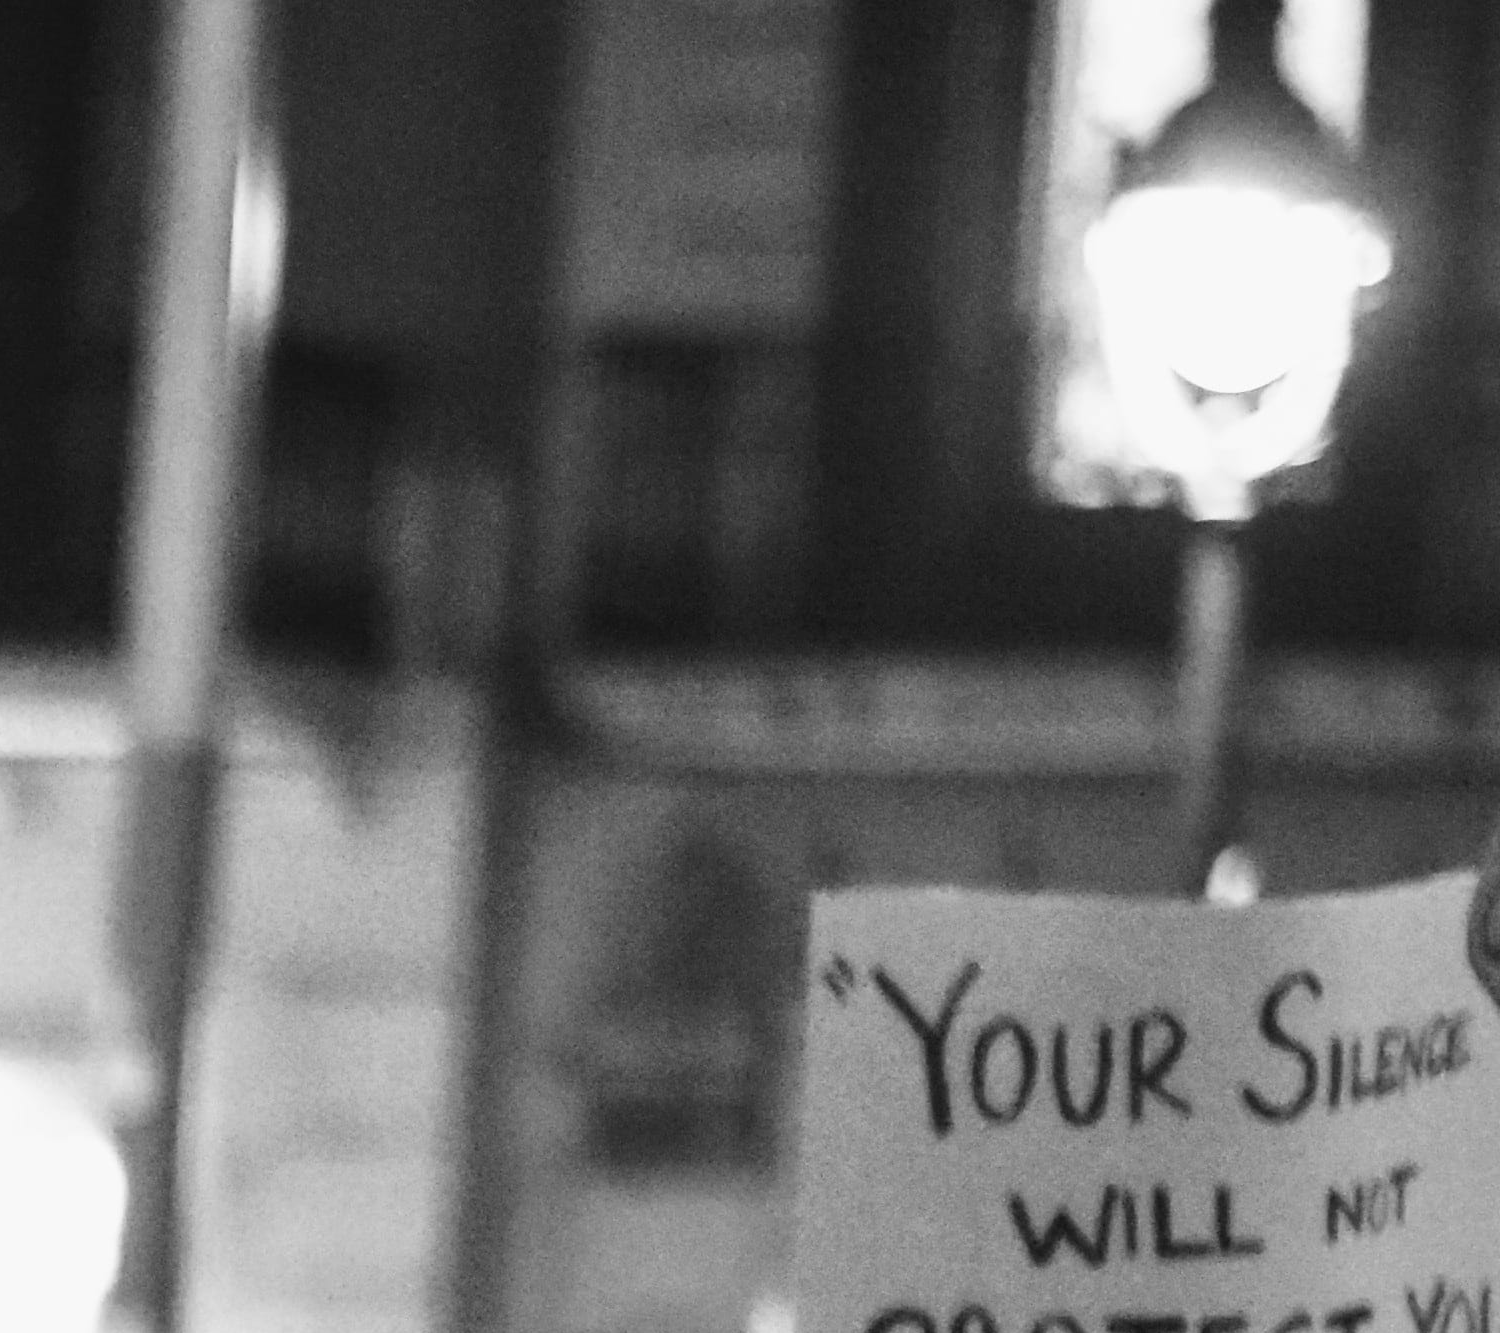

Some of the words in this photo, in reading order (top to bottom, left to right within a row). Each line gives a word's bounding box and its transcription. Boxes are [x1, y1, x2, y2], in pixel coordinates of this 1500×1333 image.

[1241, 966, 1476, 1125] SILENCE
[1008, 1184, 1264, 1267] WILL
[1325, 1163, 1419, 1246] NOT
